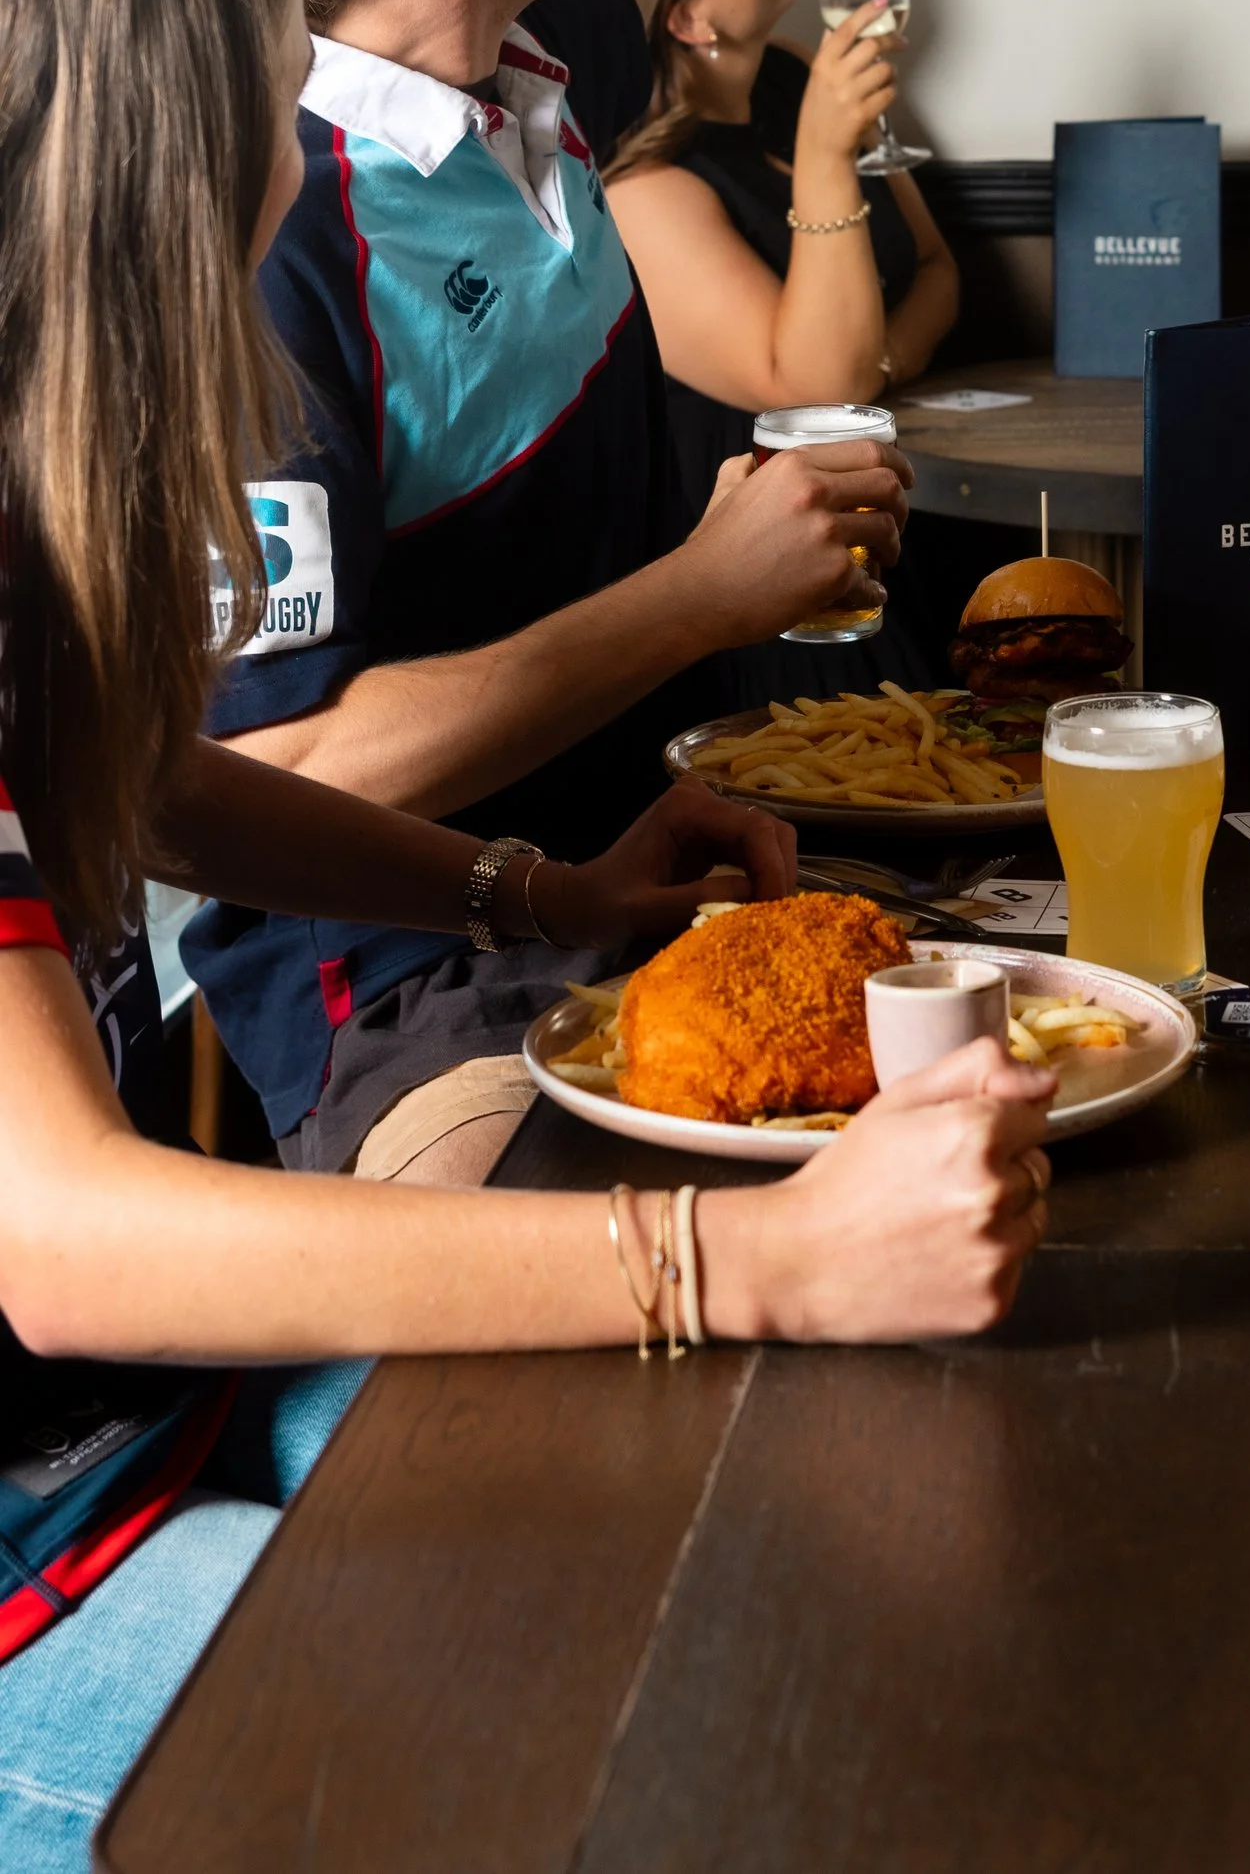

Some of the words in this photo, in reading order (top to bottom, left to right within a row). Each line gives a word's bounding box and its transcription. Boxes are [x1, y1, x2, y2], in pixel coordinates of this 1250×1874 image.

[1094, 236, 1181, 254] BELLEVUE
[467, 285, 504, 333] canterbury
[254, 592, 322, 638] UGBY
